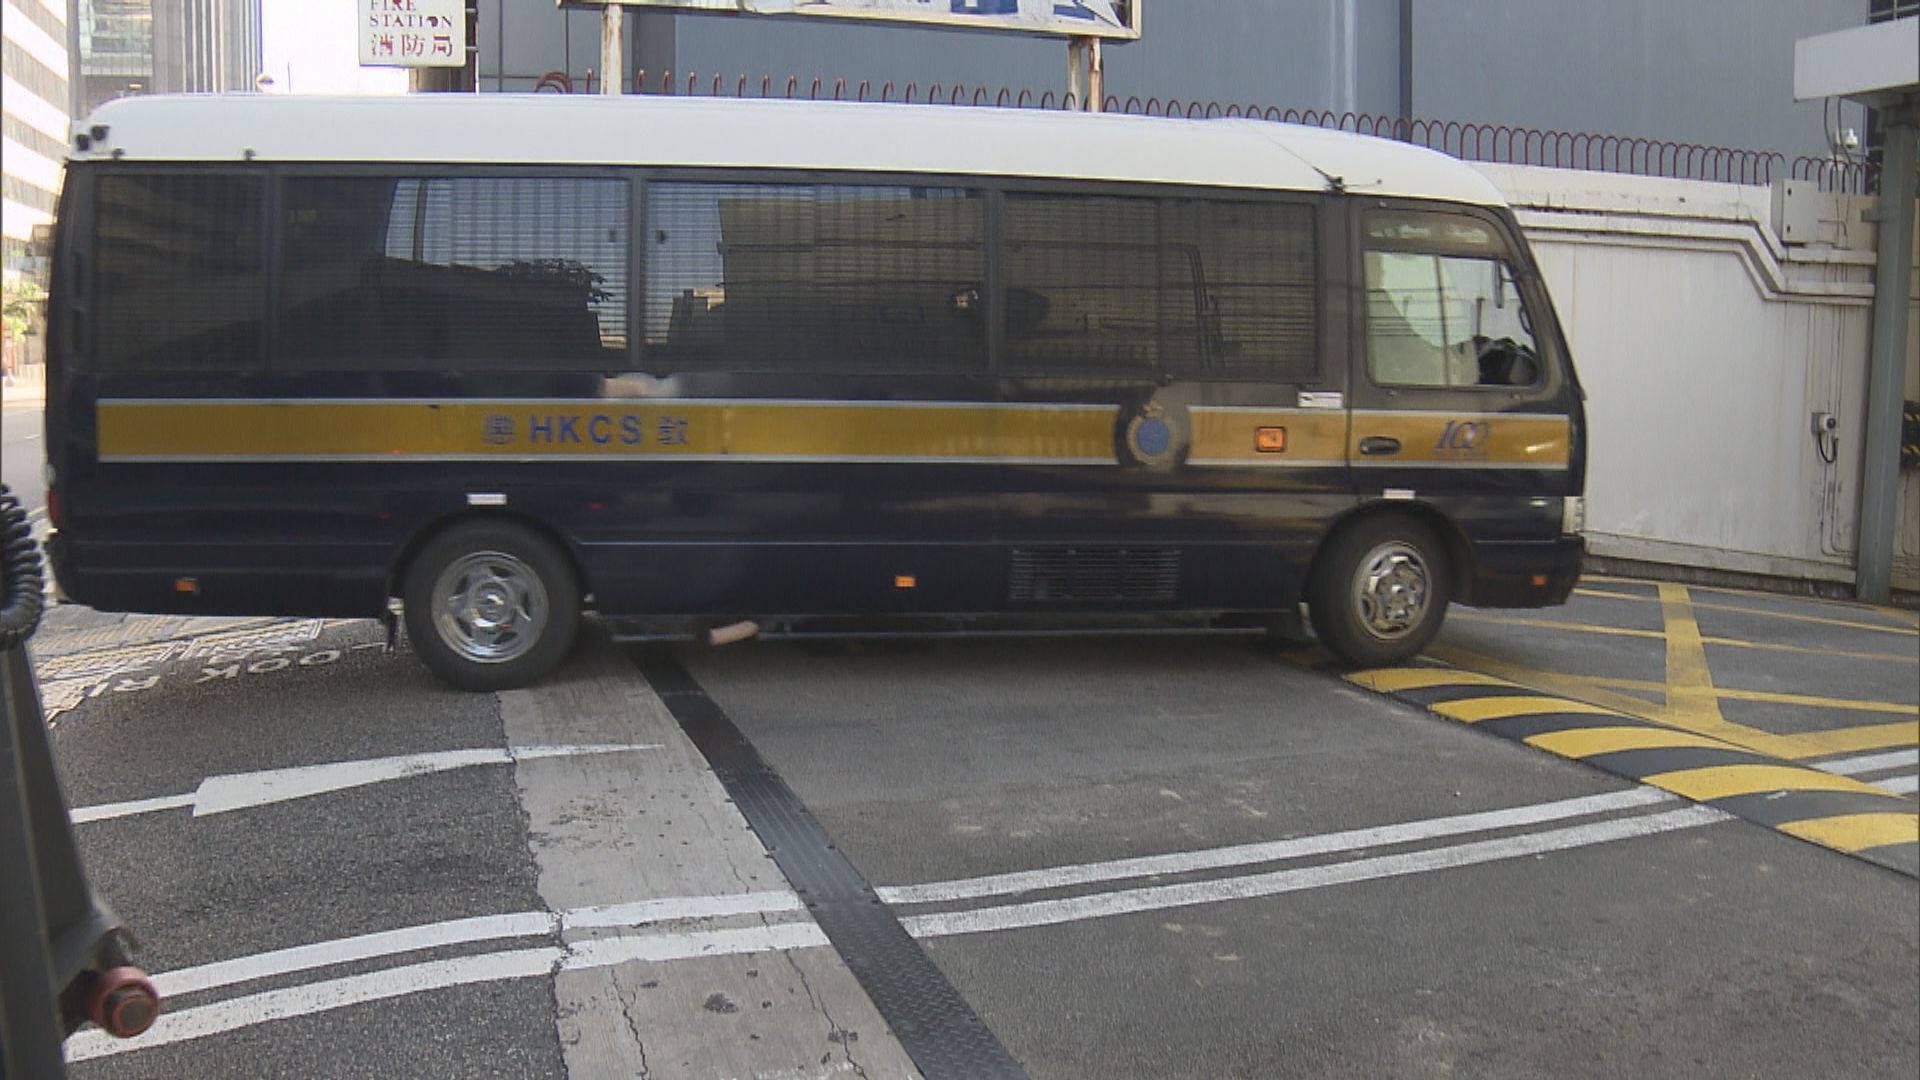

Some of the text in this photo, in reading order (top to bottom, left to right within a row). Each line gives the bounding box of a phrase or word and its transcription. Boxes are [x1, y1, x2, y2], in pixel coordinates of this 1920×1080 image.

[369, 0, 417, 11] FIRE
[369, 14, 454, 28] STATION
[371, 33, 454, 57] 消防局
[530, 413, 642, 446] HKCS
